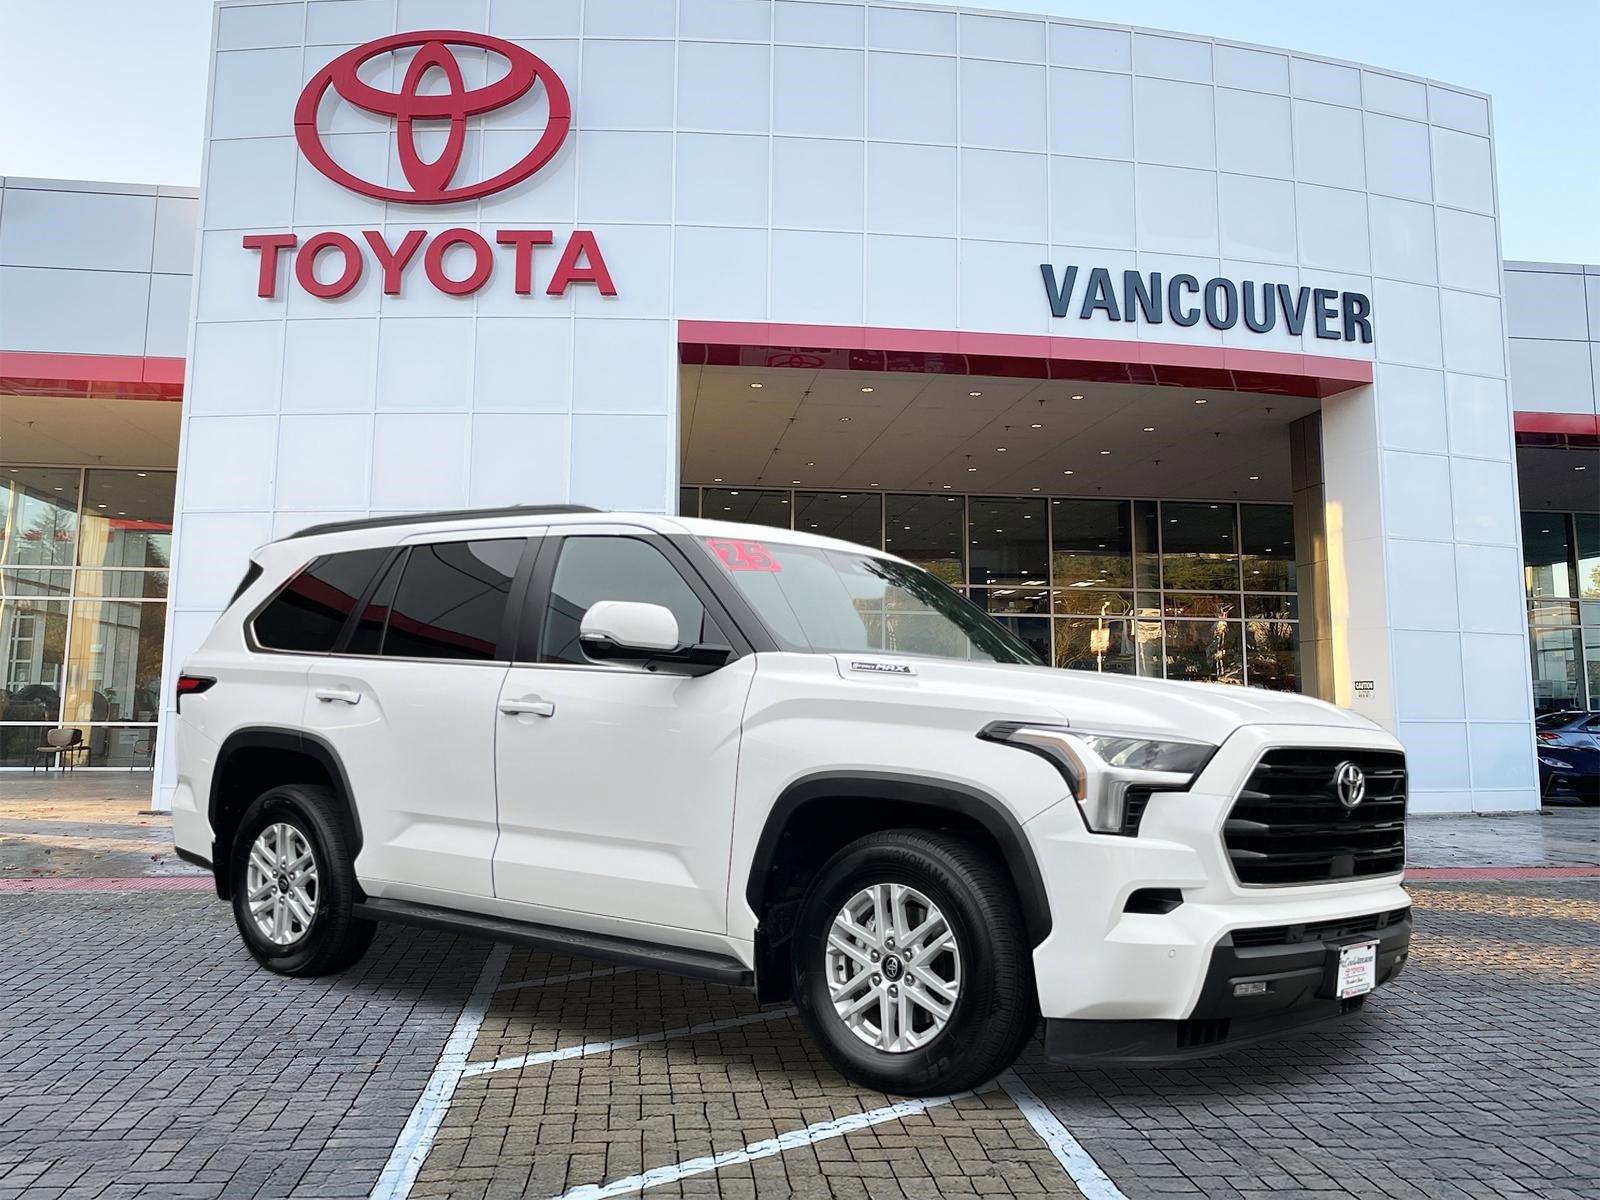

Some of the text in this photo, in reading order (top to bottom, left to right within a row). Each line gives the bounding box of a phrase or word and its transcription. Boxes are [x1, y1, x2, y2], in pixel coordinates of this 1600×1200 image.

[243, 228, 617, 298] TOYOTA
[1040, 264, 1373, 343] VANCOUVER
[712, 542, 772, 568] 25
